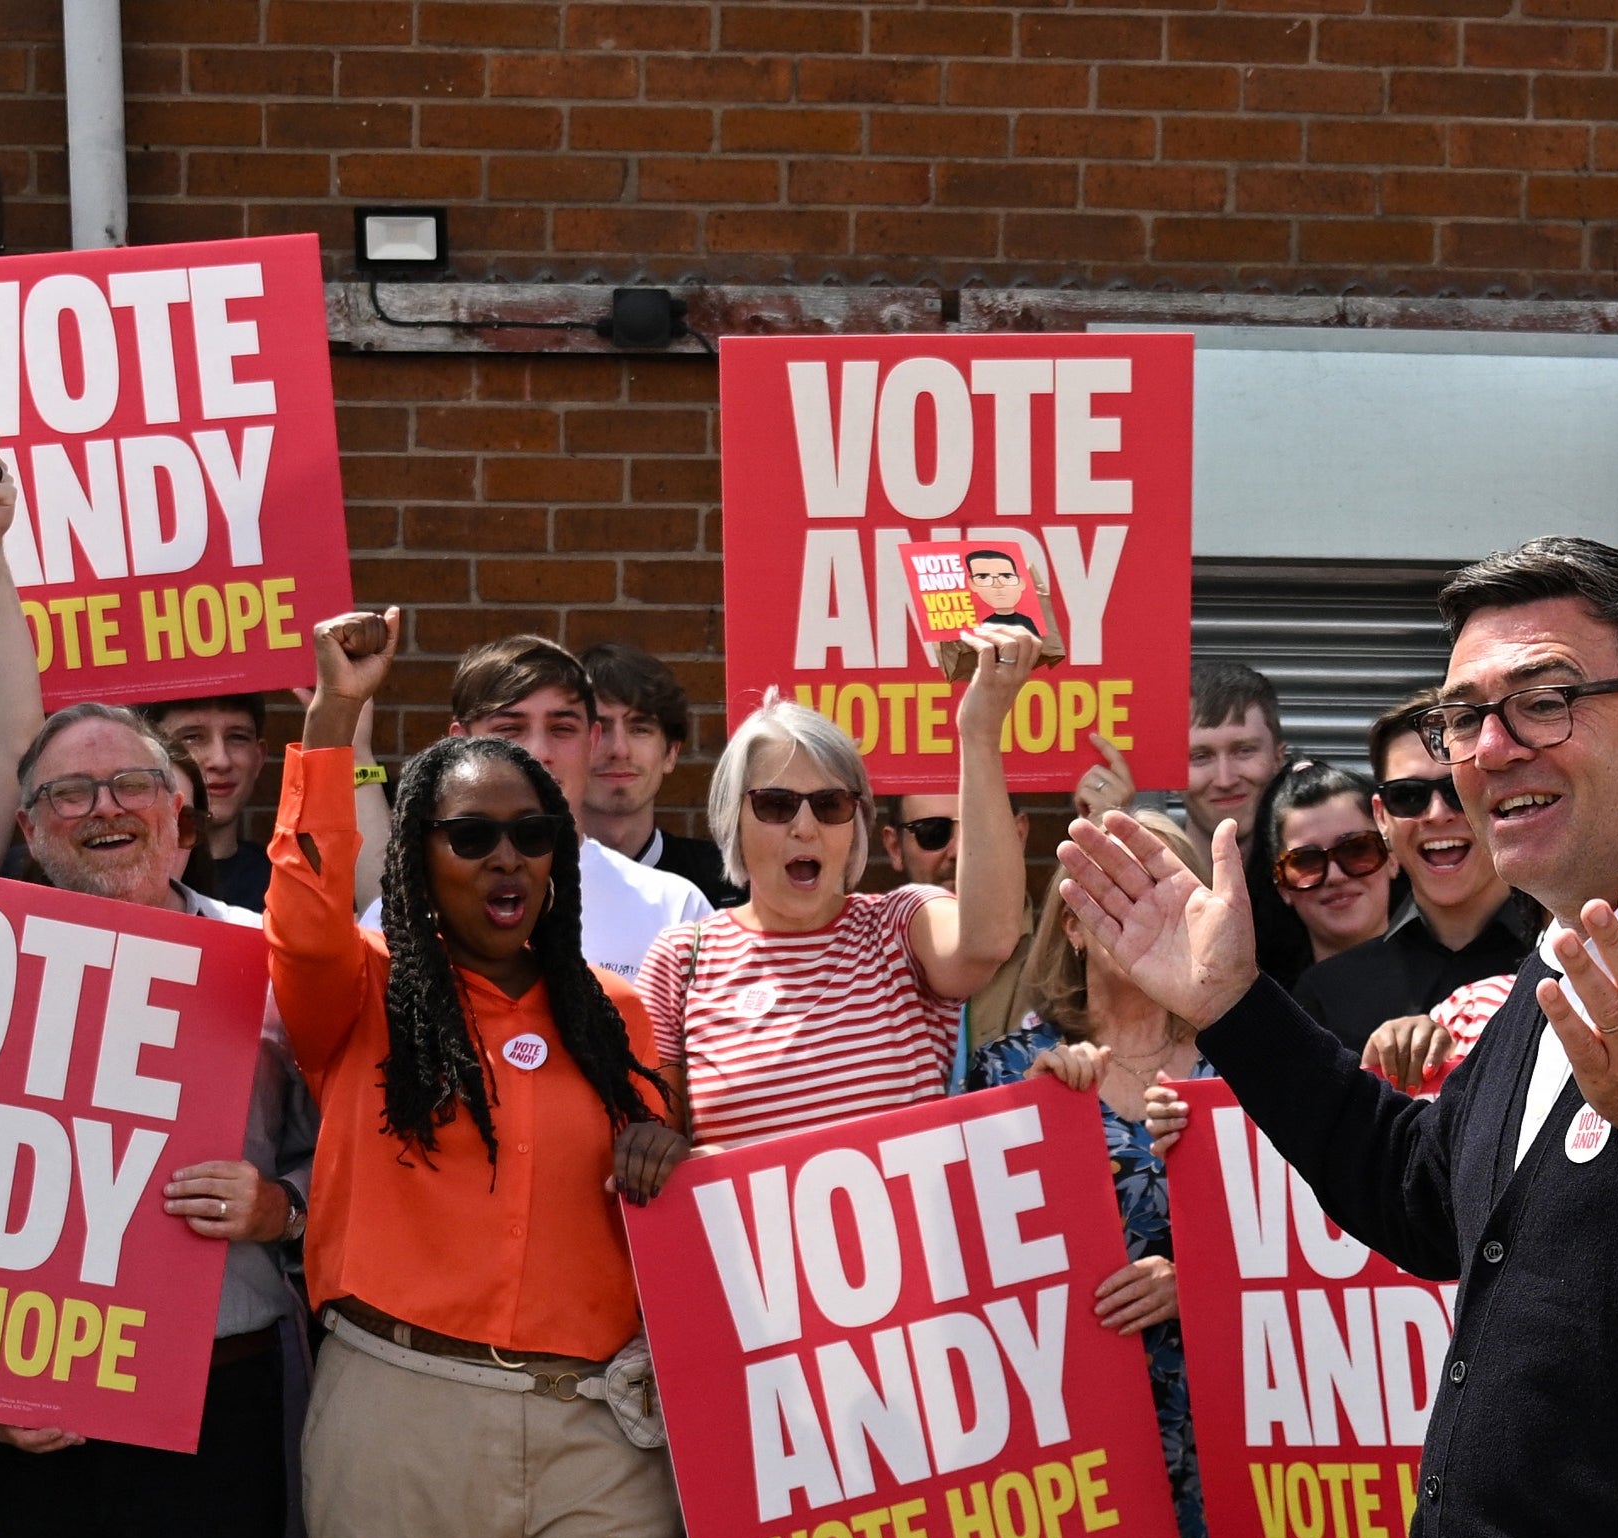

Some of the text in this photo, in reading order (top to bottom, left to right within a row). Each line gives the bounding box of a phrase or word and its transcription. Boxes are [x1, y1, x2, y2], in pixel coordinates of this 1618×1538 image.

[787, 357, 1134, 520] VOTE
[911, 554, 964, 574] VOTE
[919, 572, 967, 592] ANDY
[922, 591, 975, 613] VOTE
[141, 577, 302, 661] HOPE
[927, 611, 980, 632] HOPE
[999, 680, 1134, 753] OPE
[508, 1051, 538, 1065] ANDY
[513, 1040, 542, 1056] VOTE
[1571, 1131, 1603, 1150] ANDY
[692, 1104, 1071, 1353] VOTE
[1242, 1285, 1459, 1447] AND
[744, 1283, 1071, 1524] ANDY
